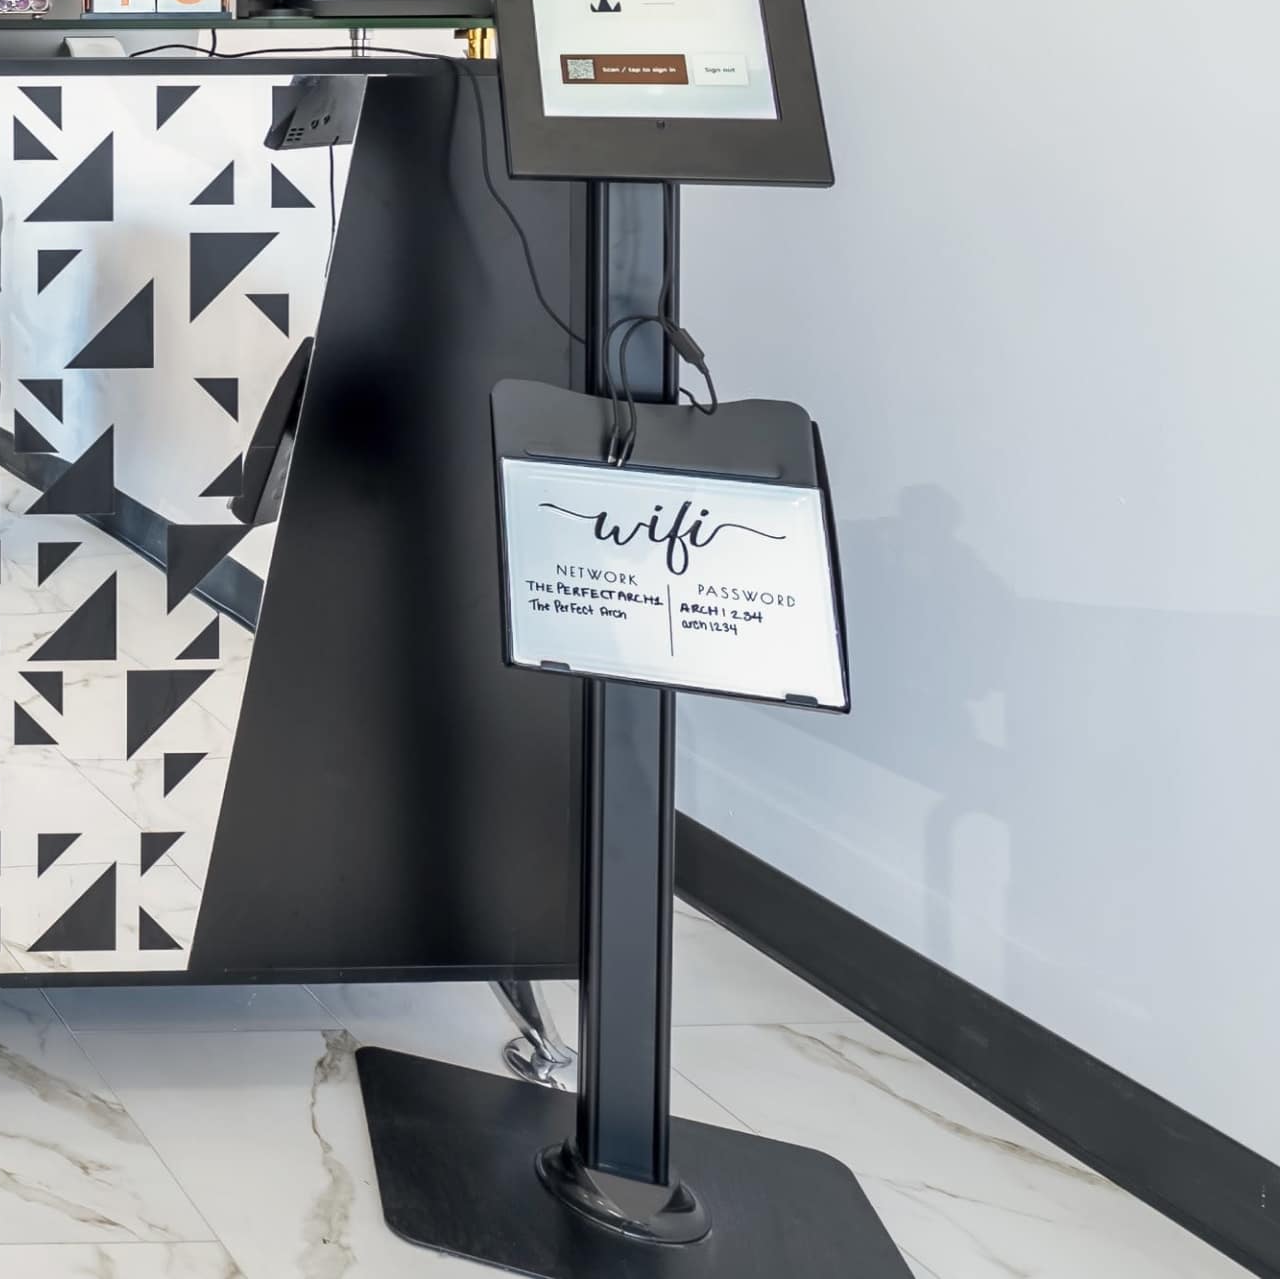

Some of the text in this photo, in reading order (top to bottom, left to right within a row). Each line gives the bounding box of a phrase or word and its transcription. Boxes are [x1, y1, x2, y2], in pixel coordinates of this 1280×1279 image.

[556, 564, 638, 586] NETWORK
[528, 598, 551, 612] The
[698, 583, 796, 608] PASSWORD
